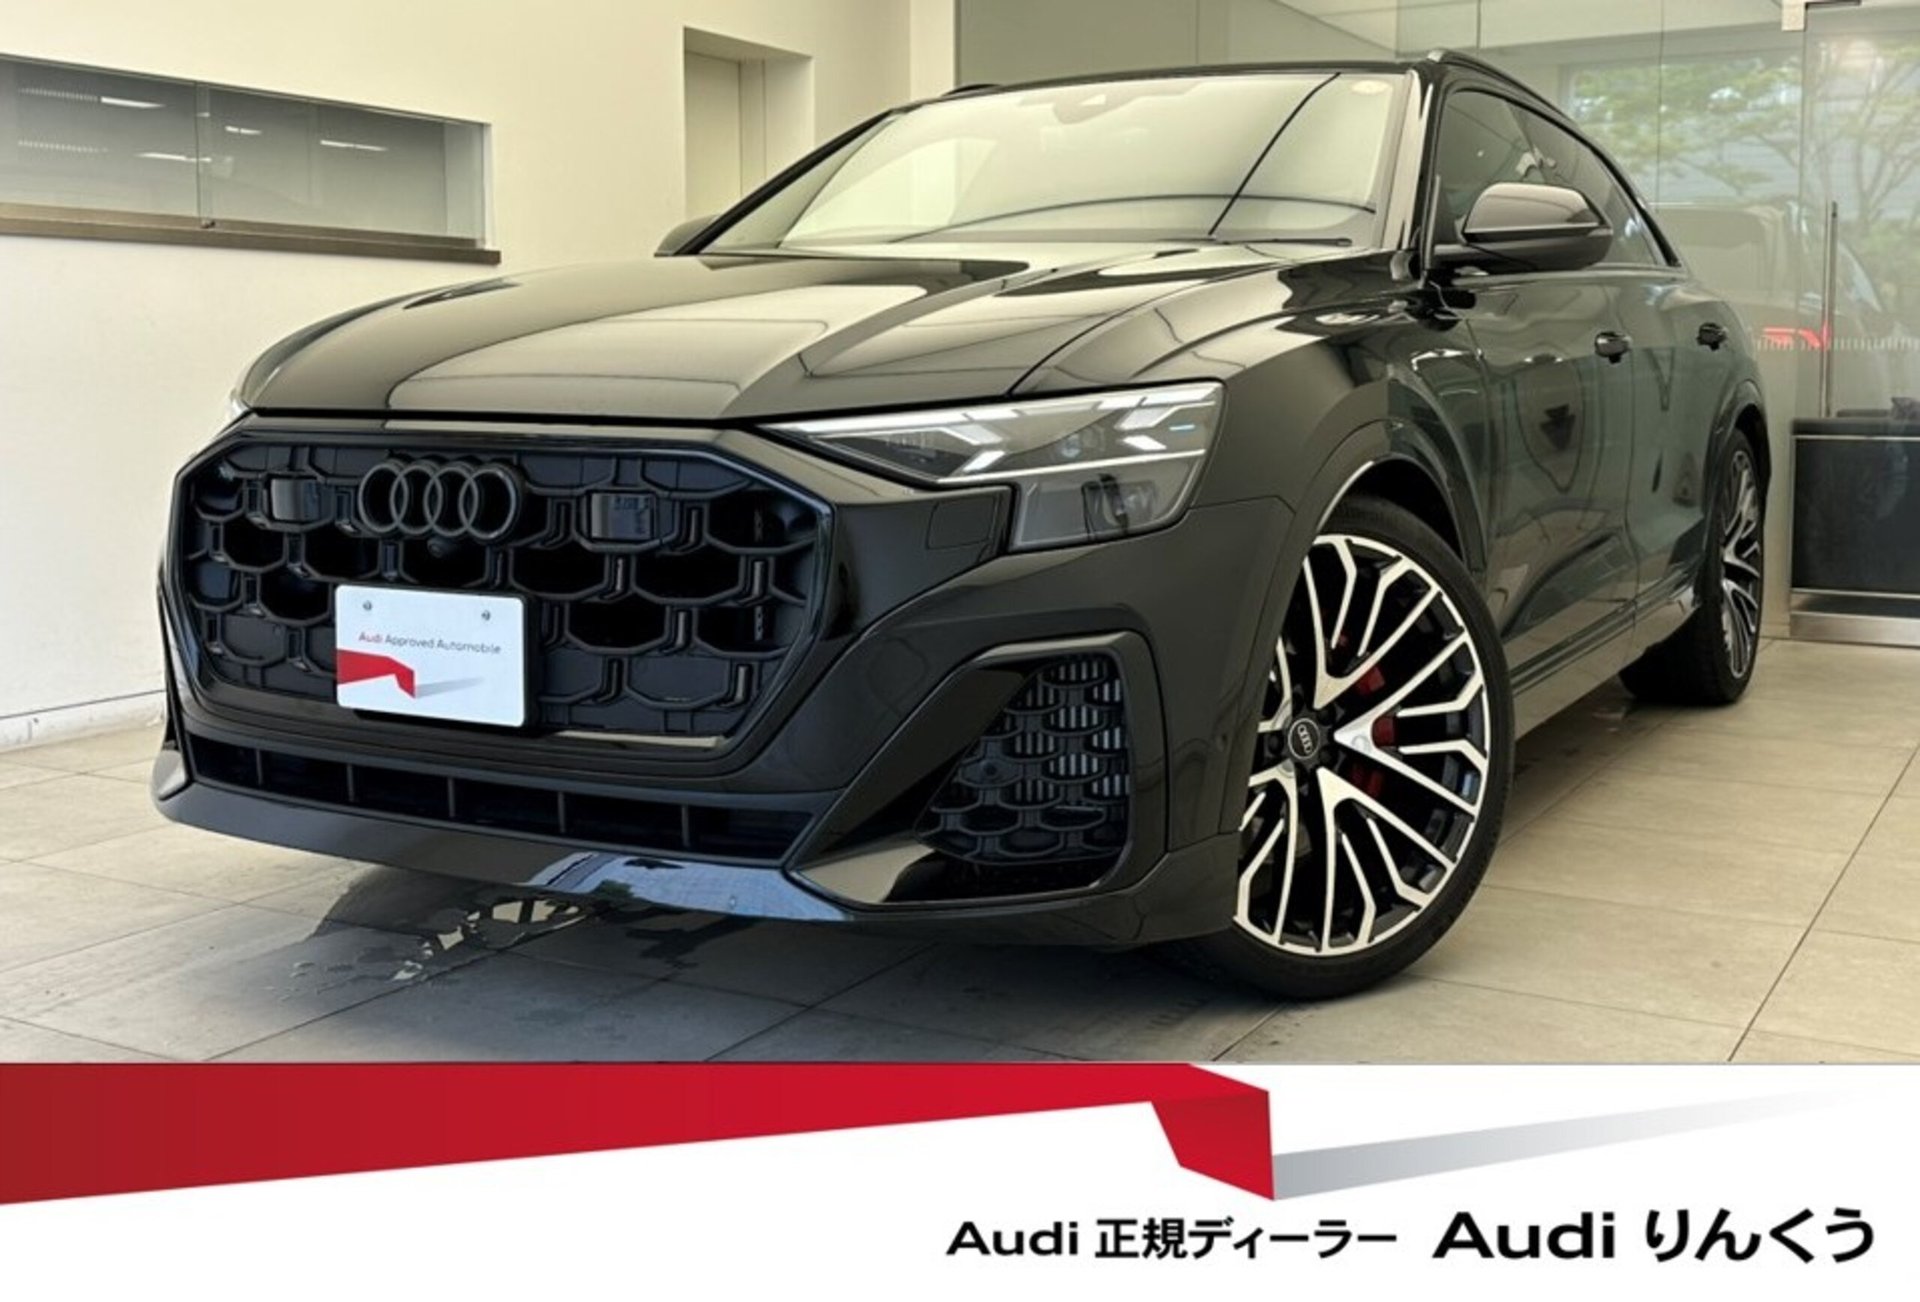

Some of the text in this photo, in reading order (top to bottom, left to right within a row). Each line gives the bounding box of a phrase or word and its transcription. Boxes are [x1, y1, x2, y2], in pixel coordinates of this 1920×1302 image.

[358, 631, 501, 654] Audi Approved Automobile
